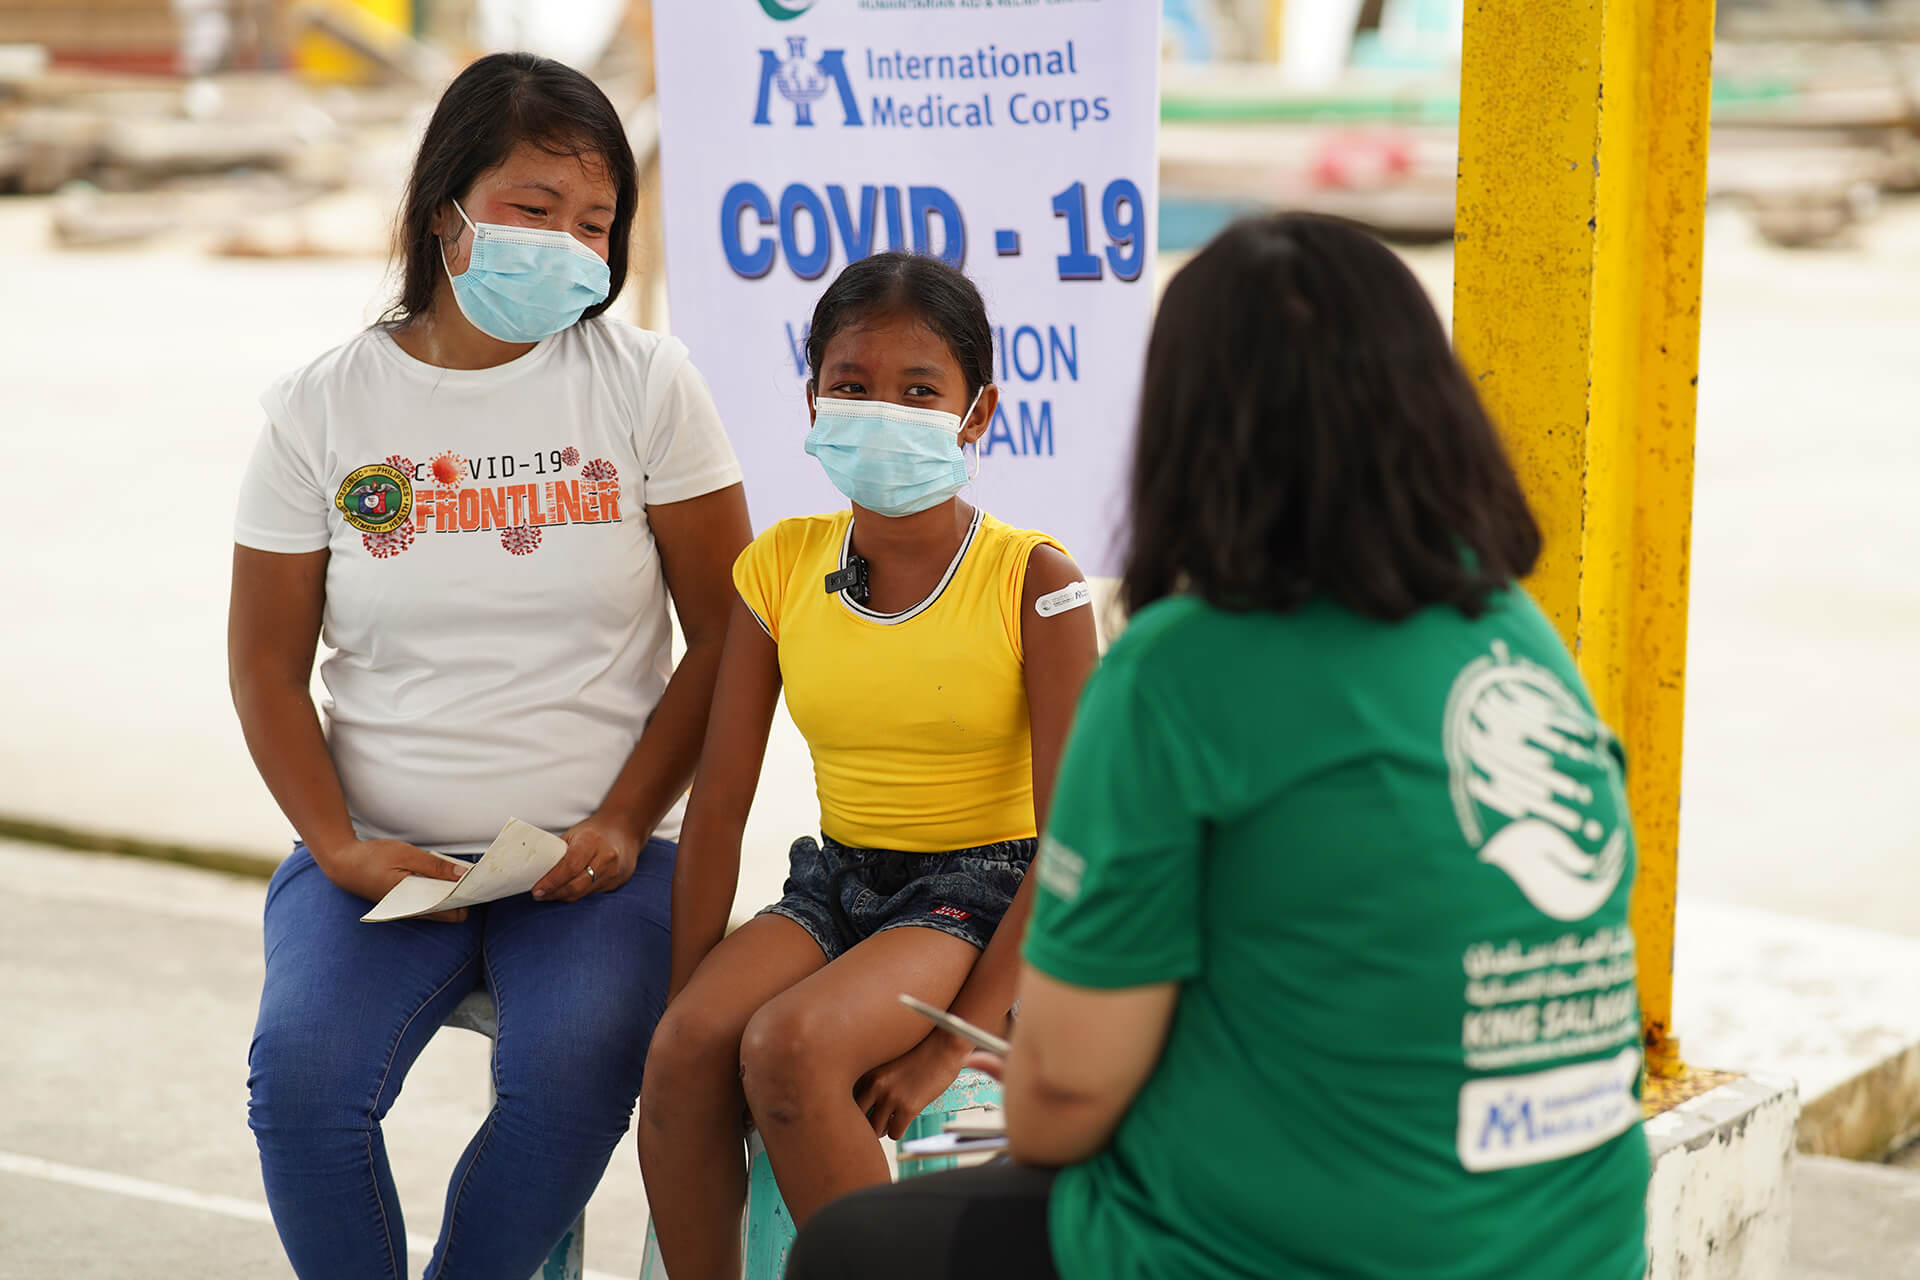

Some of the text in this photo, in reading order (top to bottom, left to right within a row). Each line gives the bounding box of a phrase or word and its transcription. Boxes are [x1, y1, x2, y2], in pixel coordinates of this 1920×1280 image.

[866, 39, 1077, 80] International
[871, 92, 1111, 131] Medical Corps
[720, 181, 967, 281] COVID
[1051, 178, 1146, 282] 19
[389, 503, 410, 529] HEALTH
[415, 479, 623, 533] FRONTLINER
